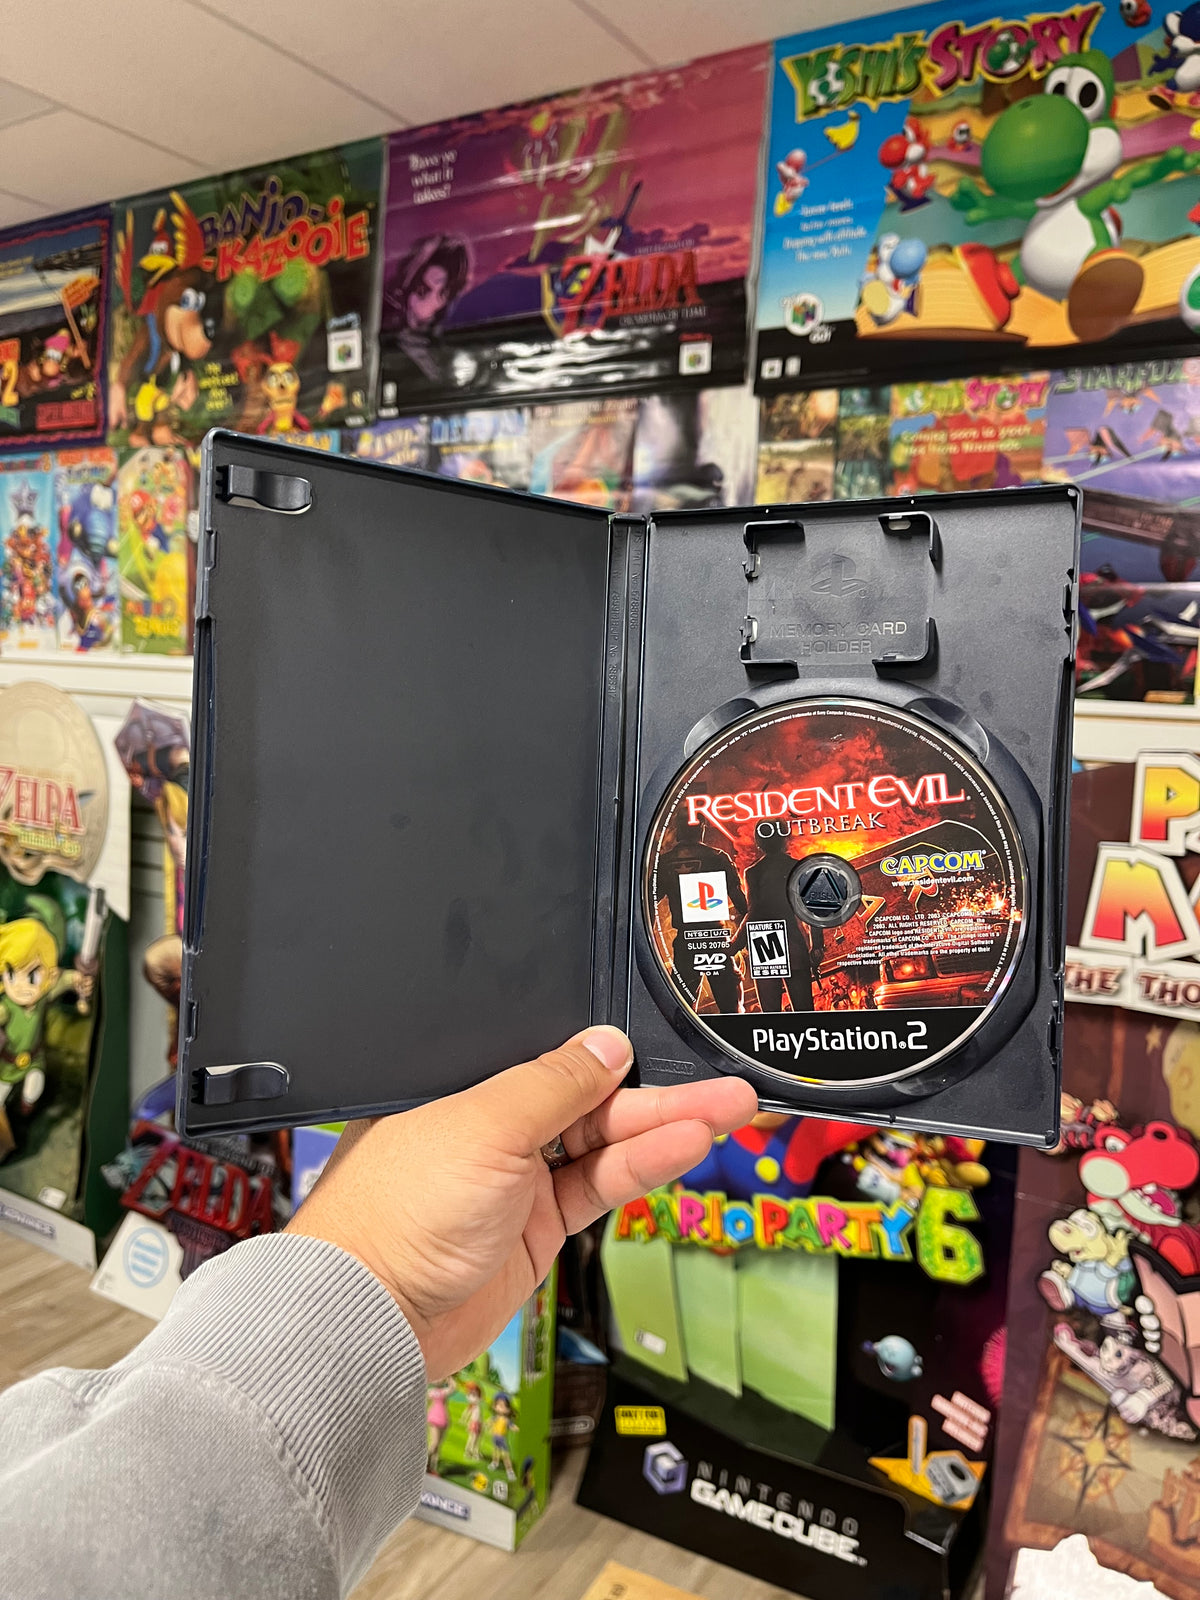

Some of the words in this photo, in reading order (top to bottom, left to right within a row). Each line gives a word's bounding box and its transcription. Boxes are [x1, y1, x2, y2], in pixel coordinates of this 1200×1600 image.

[787, 35, 926, 120] YOSHI'S
[926, 5, 1103, 94] STORY
[559, 251, 703, 337] ZELDA
[950, 429, 979, 440] soon
[981, 426, 997, 438] to
[770, 622, 849, 639] MEMORY
[856, 621, 908, 636] CARD
[801, 639, 873, 656] HOLDER
[686, 783, 864, 842] RESIDENT
[867, 773, 965, 808] EVIL
[1136, 758, 1200, 849] P
[756, 811, 886, 840] OUTBREAK
[880, 850, 985, 876] CAPCOM
[749, 923, 773, 931] MATURE
[774, 922, 784, 930] 17+
[687, 942, 708, 950] SLUS
[709, 941, 730, 949] 20765
[693, 953, 728, 966] DVD
[752, 931, 786, 964] M
[752, 1026, 898, 1060] PlayStation
[906, 1020, 929, 1050] 2
[616, 1192, 756, 1247] MARIO
[753, 1194, 914, 1260] PARTY
[916, 1186, 985, 1284] 6
[696, 1460, 860, 1537] NINTENDO
[690, 1478, 862, 1564] GAMECUBE
